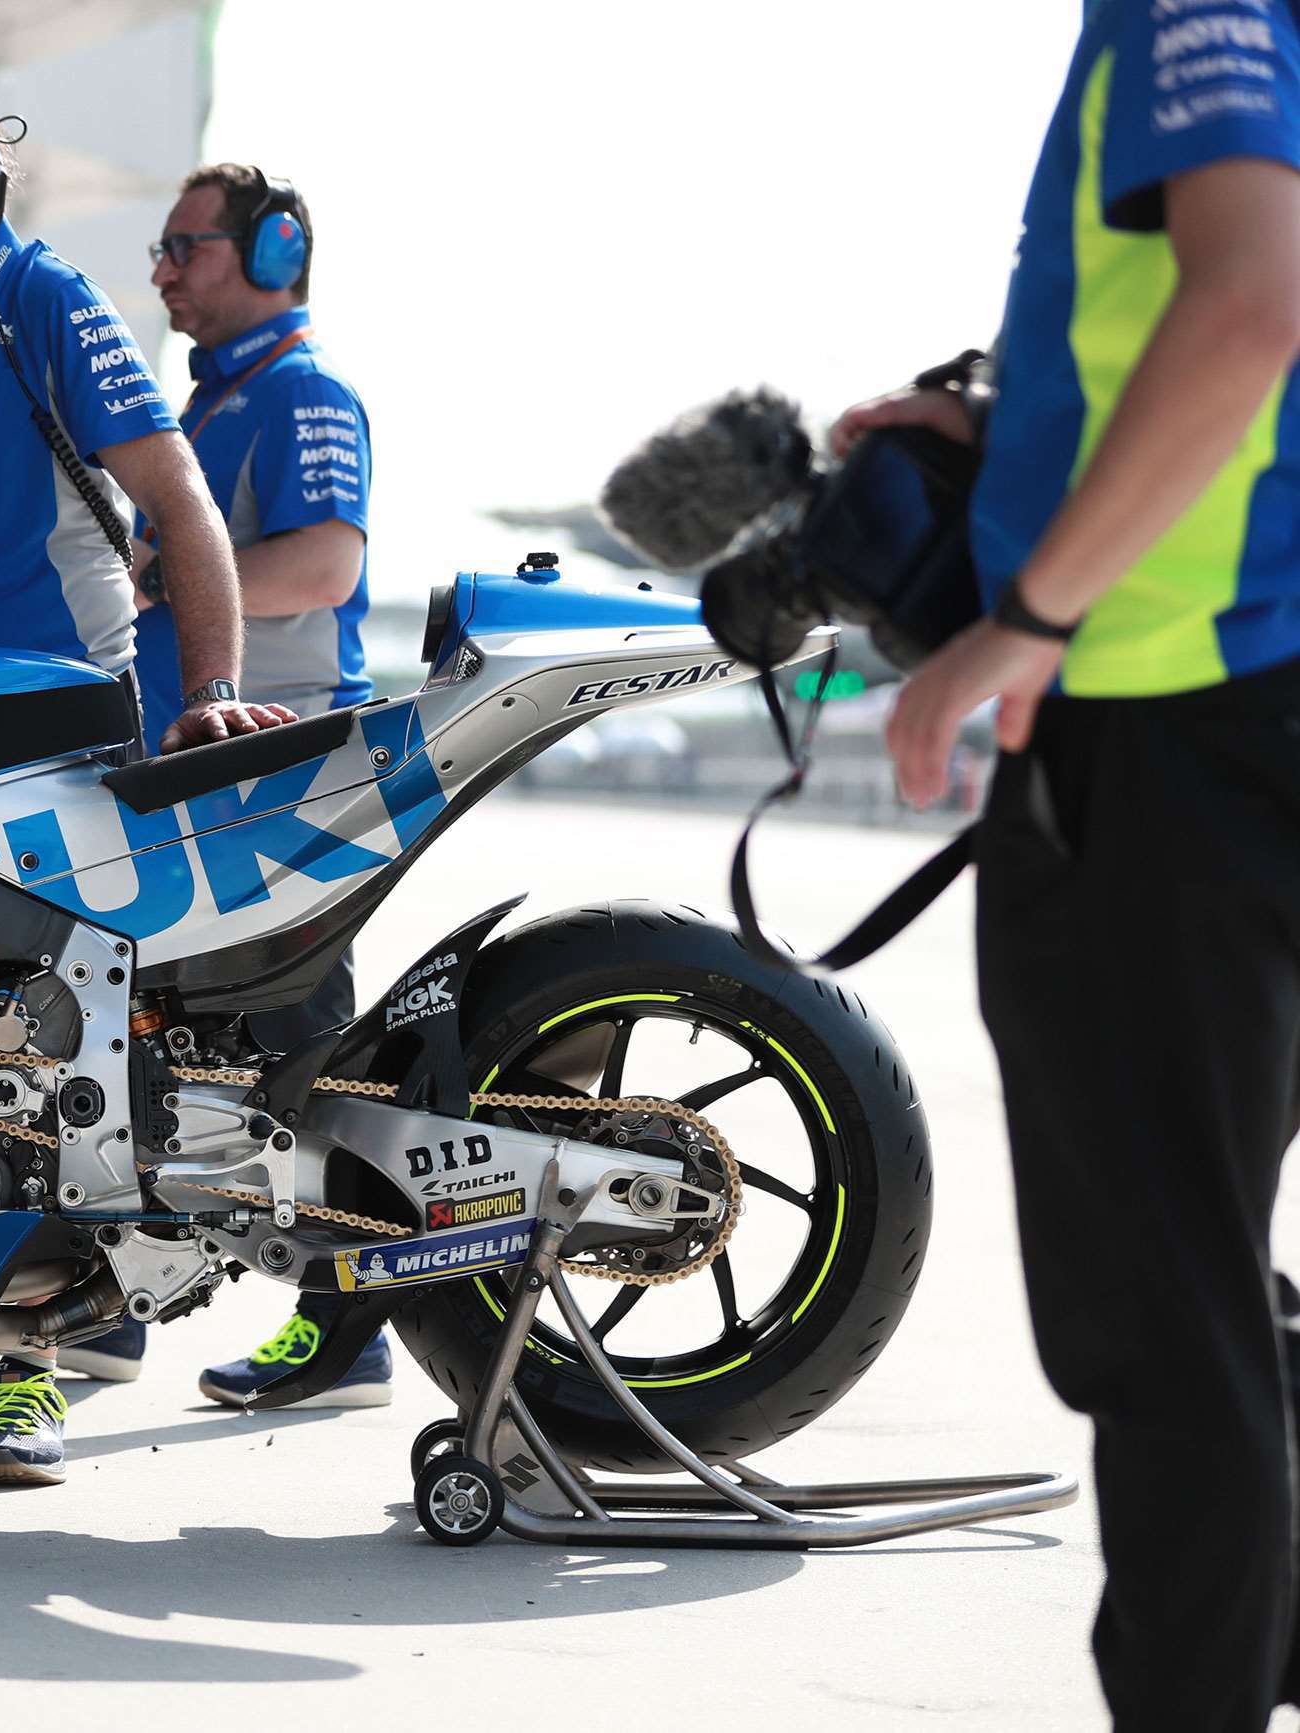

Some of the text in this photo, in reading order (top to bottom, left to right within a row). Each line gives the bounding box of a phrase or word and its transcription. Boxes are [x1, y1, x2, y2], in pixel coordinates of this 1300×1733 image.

[300, 445, 359, 468] MOTUL
[563, 658, 741, 710] ECSTAR
[386, 976, 453, 1024] NGK
[386, 1001, 456, 1032] SPARK PLUGS
[405, 1134, 492, 1178] D.I.D
[442, 1171, 516, 1194] TAICHI
[454, 1190, 522, 1223] AKRAPOVIČ
[396, 1232, 532, 1274] MICHELIN
